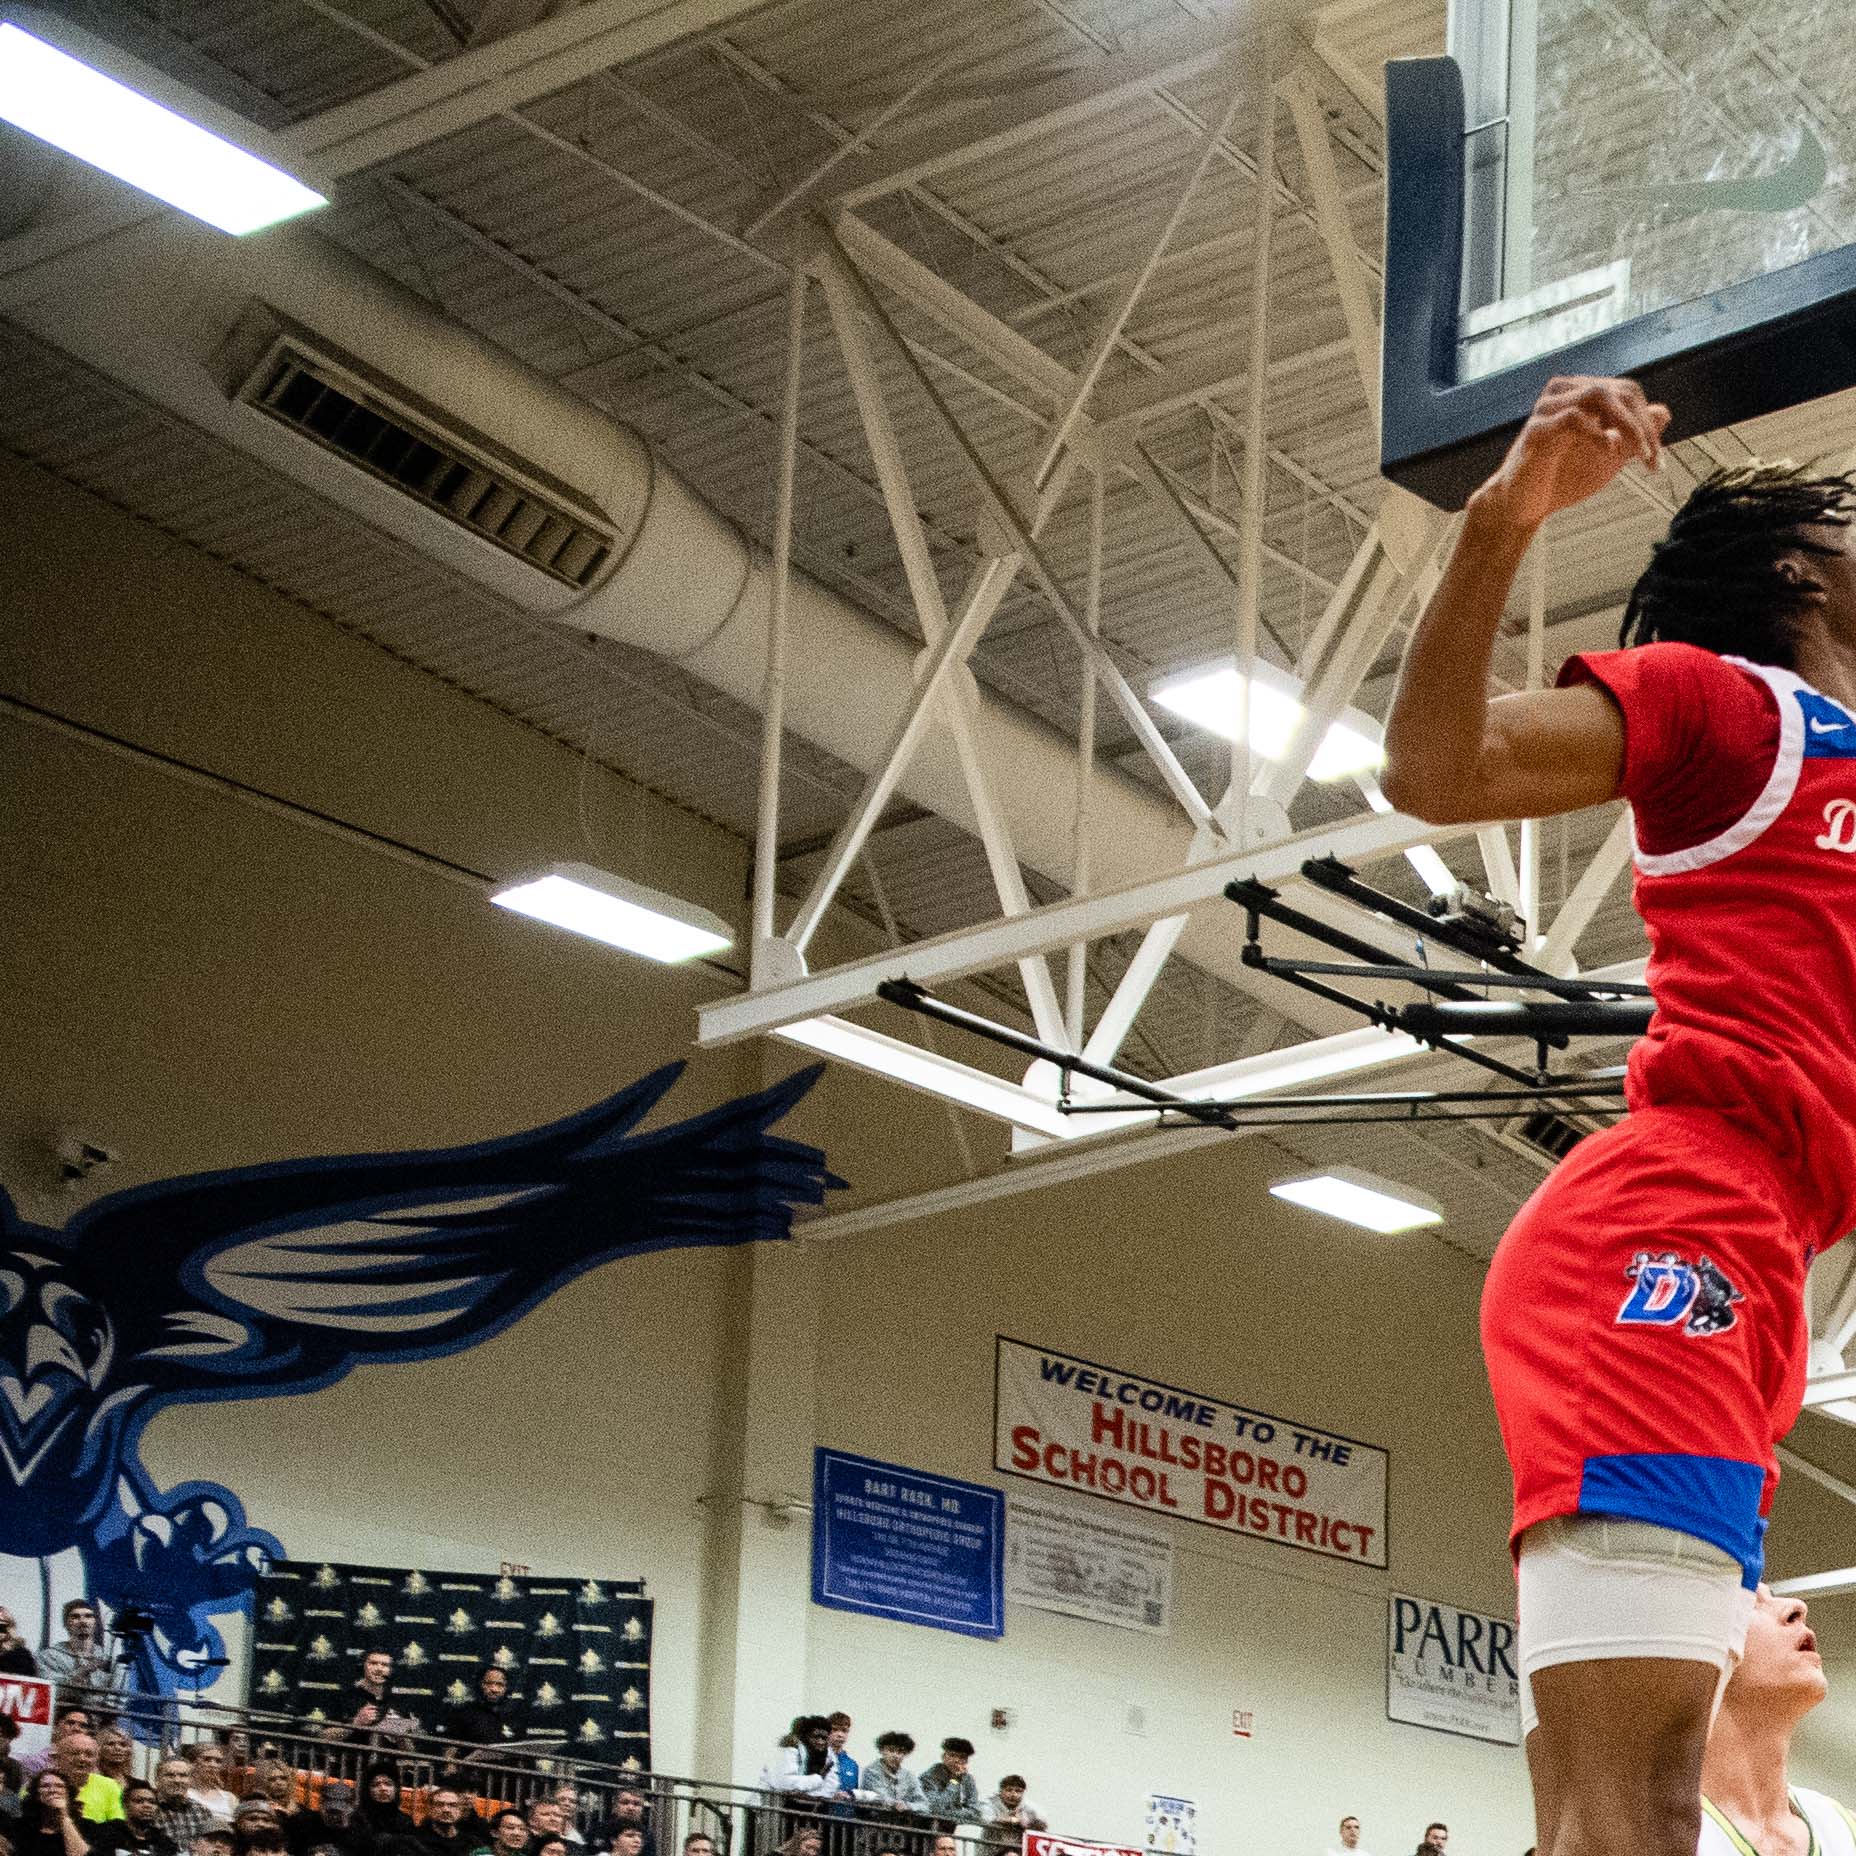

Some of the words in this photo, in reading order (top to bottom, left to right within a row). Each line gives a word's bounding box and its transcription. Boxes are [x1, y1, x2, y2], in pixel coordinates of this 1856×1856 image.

[1040, 1356, 1217, 1429] WELCOME
[1232, 1413, 1277, 1445] TO
[1292, 1430, 1354, 1468] THE
[1091, 1402, 1308, 1500] HILLSBORO
[1011, 1425, 1178, 1508] SCHOOL
[1203, 1477, 1375, 1558] DISTRICT
[1394, 1597, 1519, 1681] PARR
